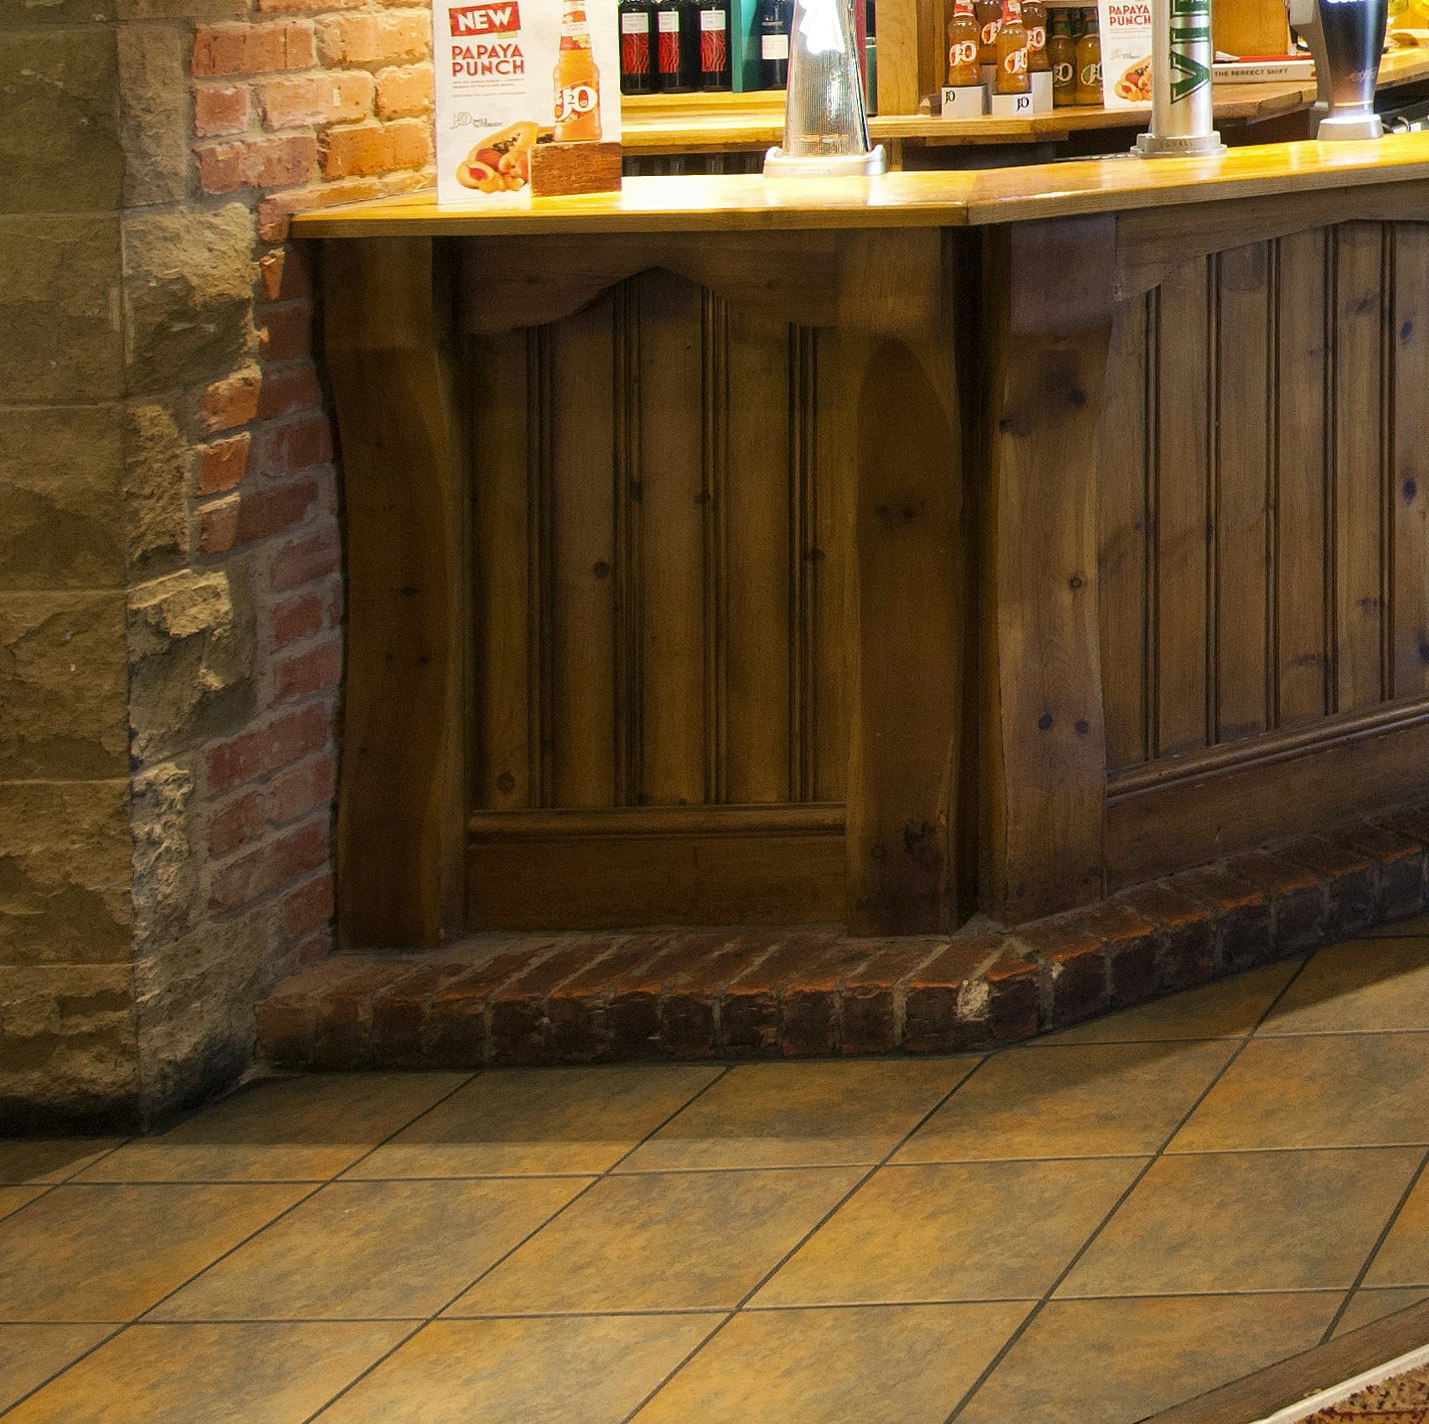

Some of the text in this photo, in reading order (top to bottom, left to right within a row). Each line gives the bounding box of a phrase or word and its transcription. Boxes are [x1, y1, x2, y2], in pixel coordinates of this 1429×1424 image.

[456, 6, 513, 32] NEW
[1108, 4, 1151, 16] PAPAYA
[1109, 14, 1152, 27] PUNCH
[451, 42, 524, 60] PAPAYA
[451, 59, 526, 77] PUNCH
